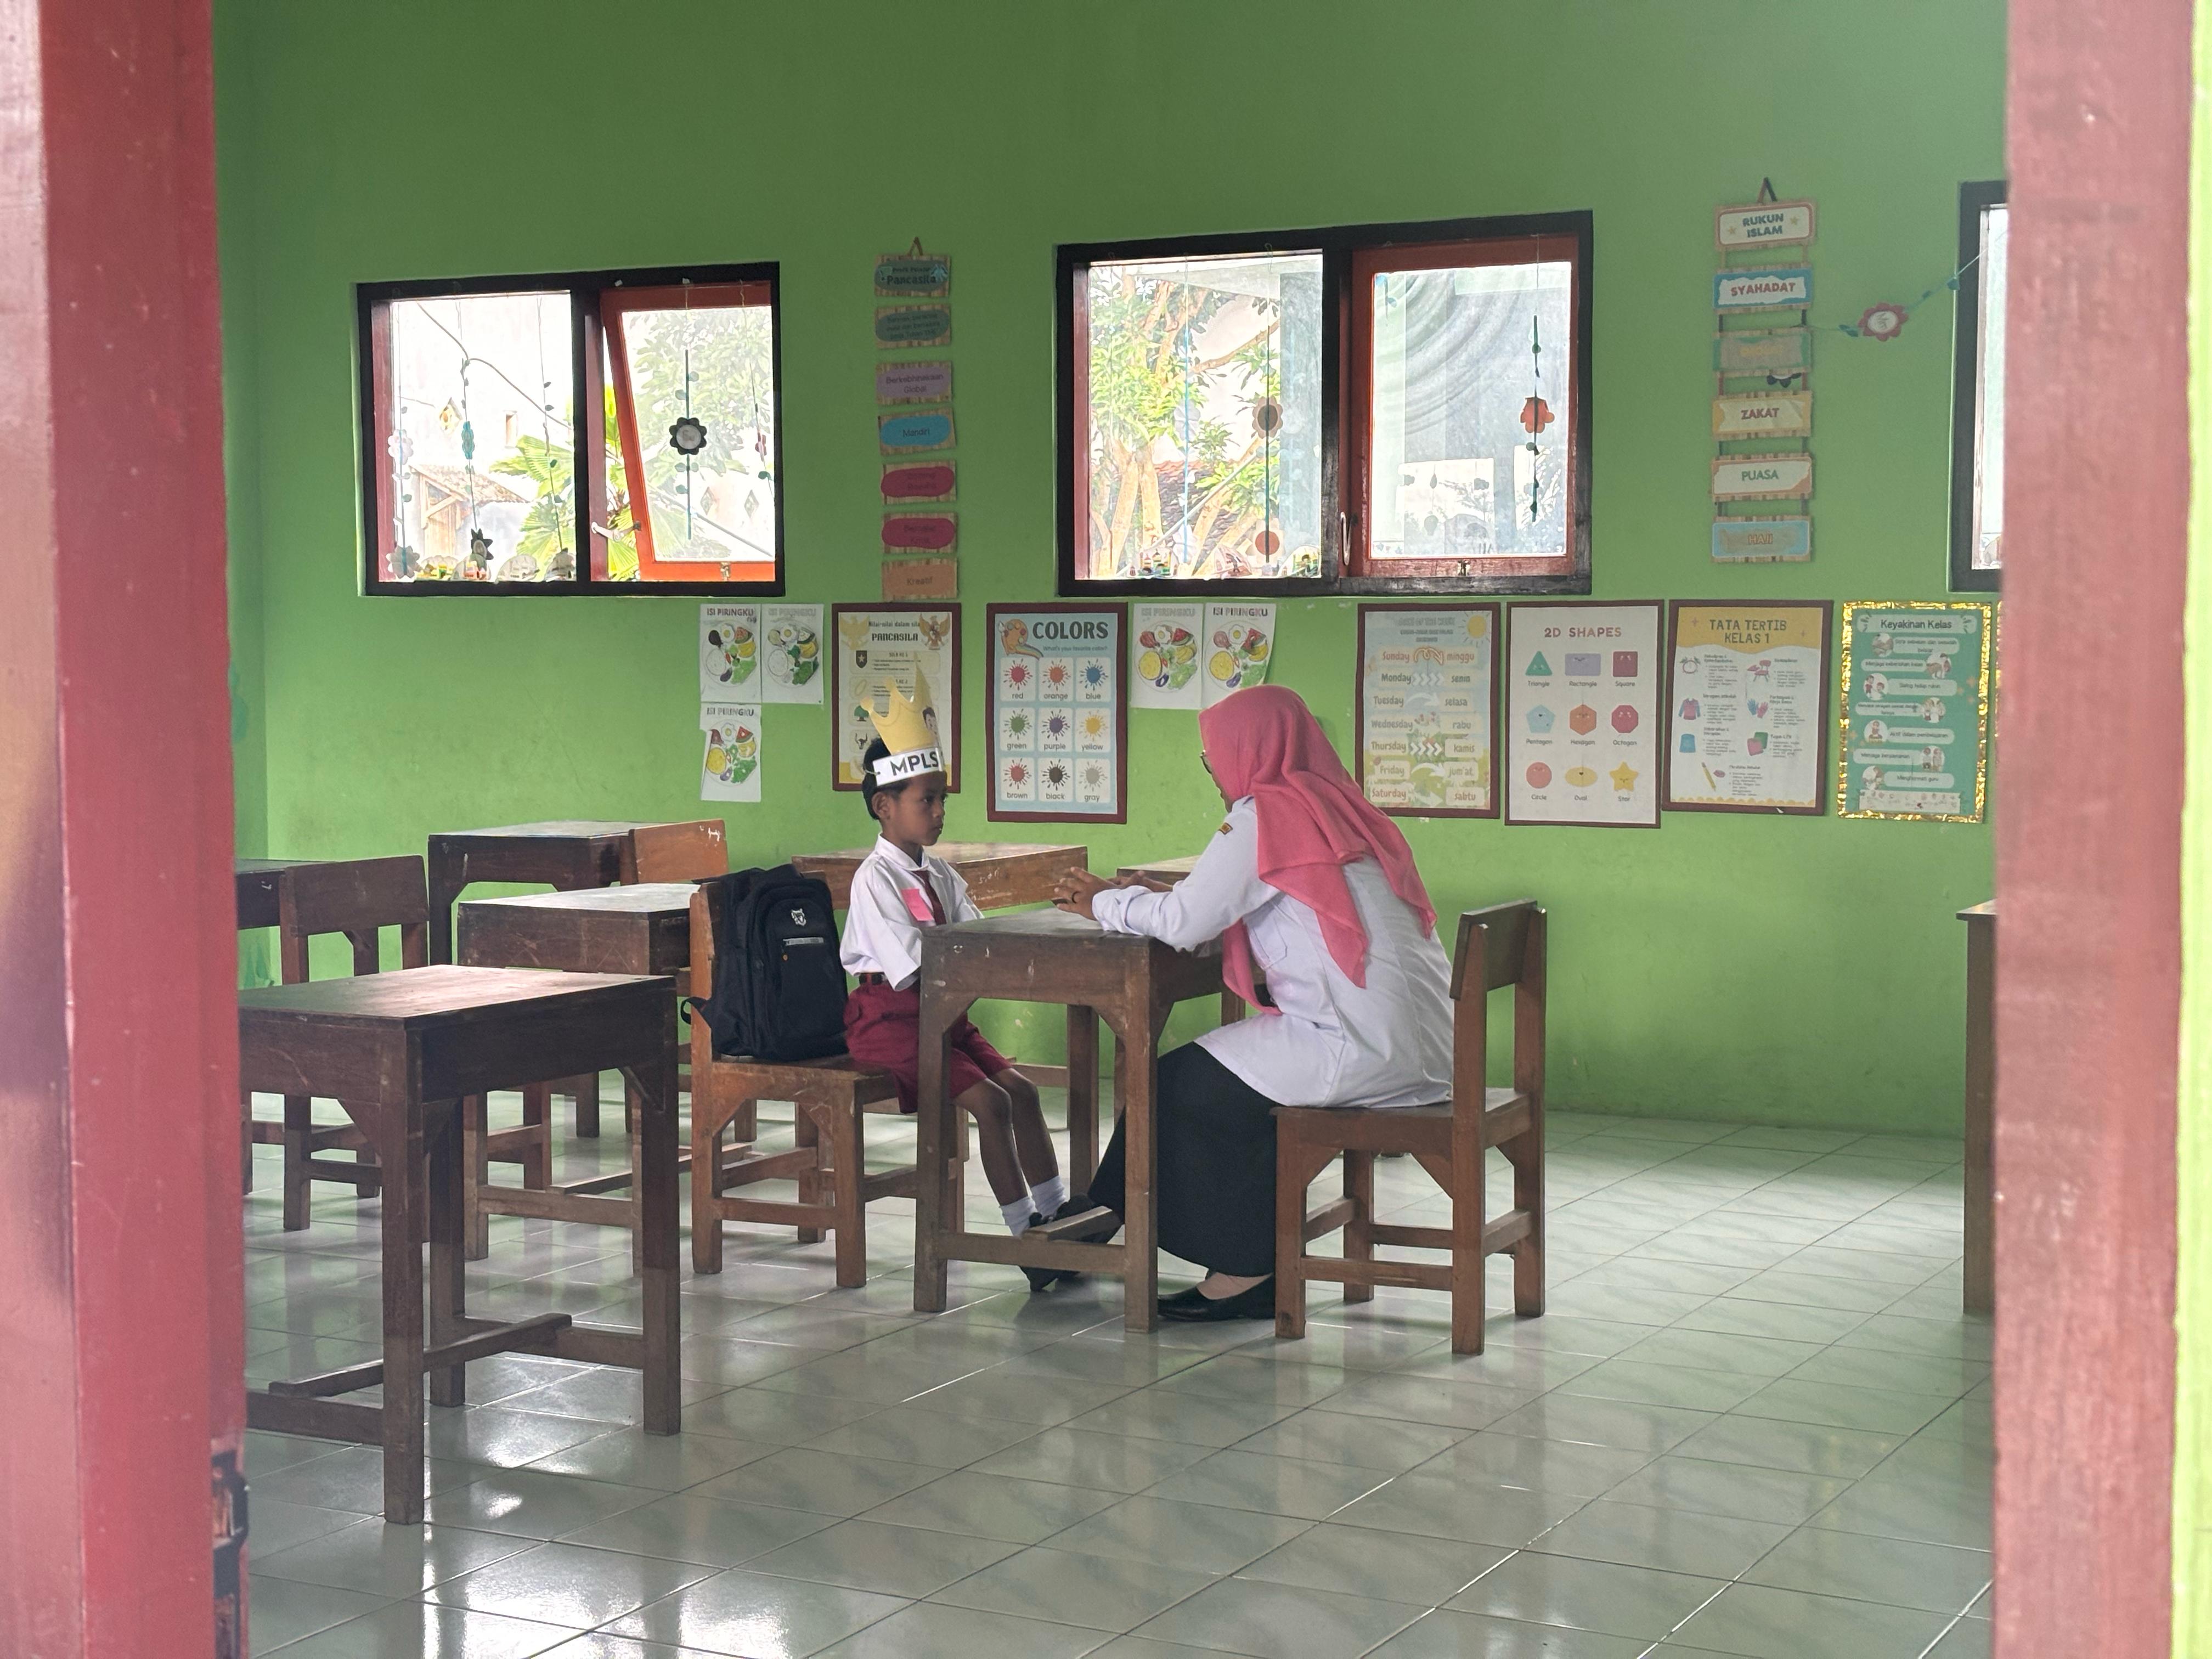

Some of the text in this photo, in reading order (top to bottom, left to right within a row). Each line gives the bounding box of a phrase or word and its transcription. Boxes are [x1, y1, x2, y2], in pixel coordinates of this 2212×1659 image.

[1742, 213, 1784, 227] RUKUN
[1747, 225, 1782, 238] ISLAM
[887, 275, 936, 285] Pancasila
[1731, 282, 1796, 297] SYAHADAT
[1741, 408, 1780, 420] ZAKAT
[903, 428, 930, 437] Mandiri
[1742, 469, 1779, 481] PUASA
[717, 608, 754, 617] PIRINGKU
[1213, 607, 1268, 617] ISI PIRINGKU
[1709, 619, 1787, 630] TATA TERTIB
[1881, 619, 1952, 630] Keyakinan Kelas
[1032, 621, 1109, 640] COLORS
[1544, 627, 1622, 637] 2D SHAPES
[872, 633, 918, 641] PANCASILA
[1725, 633, 1770, 644] KELAS 1
[1383, 651, 1475, 665] Sunday minggu
[1381, 673, 1412, 684] Monday
[1374, 696, 1468, 707] Tuesday selasa
[718, 708, 754, 716] PIRINGKU
[1371, 719, 1471, 731] Wednesday rabu
[1043, 743, 1066, 751] purple
[1081, 743, 1103, 752] yellow
[1371, 741, 1475, 753] Thursday kamis
[890, 751, 939, 776] MPLS
[1379, 767, 1405, 778] Friday
[1372, 788, 1476, 800] Saturday sabtu
